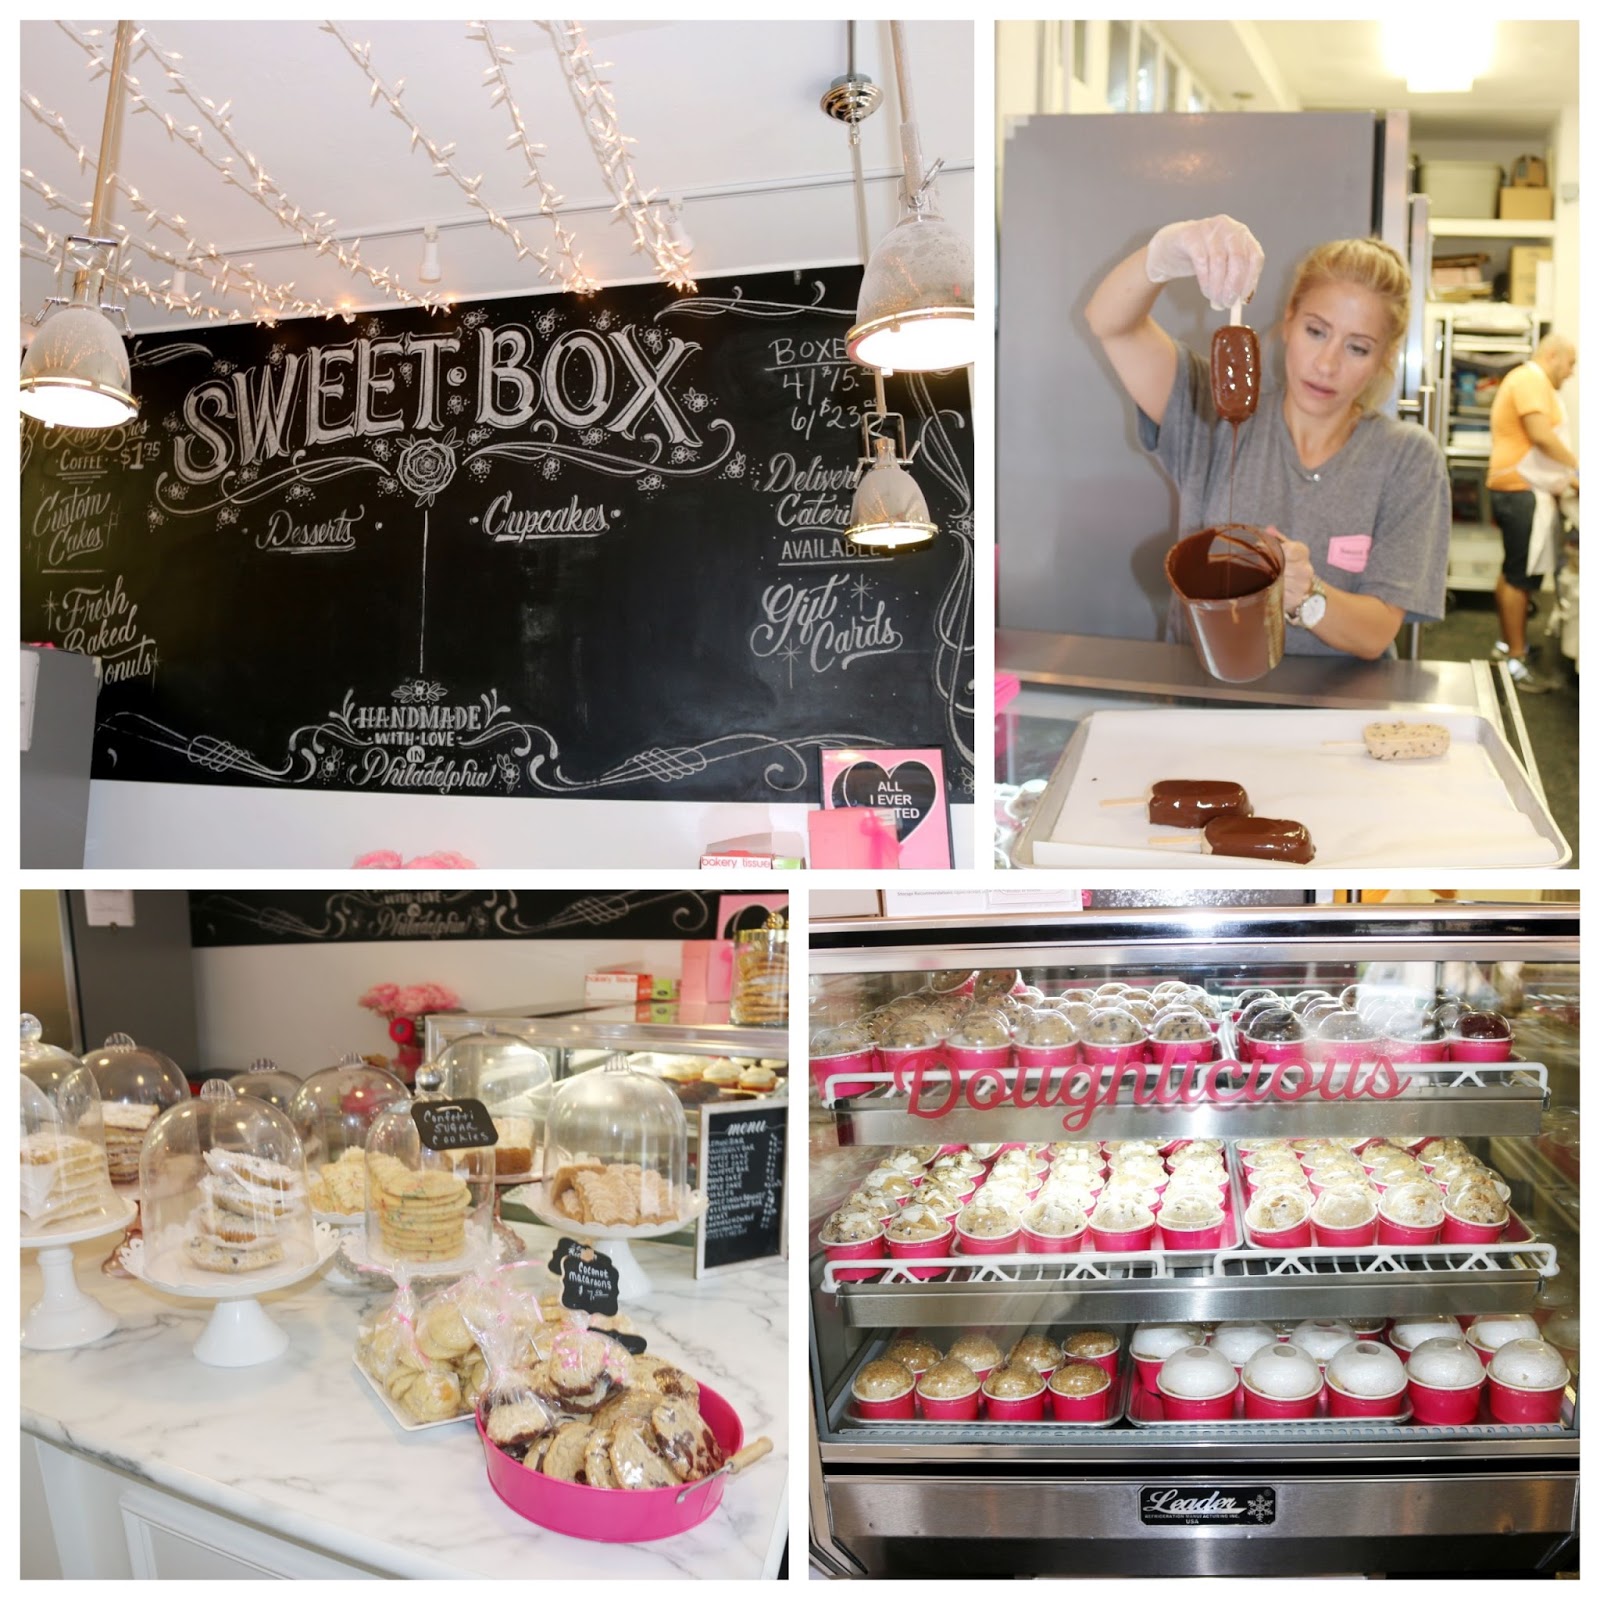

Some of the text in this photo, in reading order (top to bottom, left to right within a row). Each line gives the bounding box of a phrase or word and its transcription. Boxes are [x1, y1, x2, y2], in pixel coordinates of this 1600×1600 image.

[768, 338, 846, 365] BOXE
[175, 322, 702, 484] SWEET BOX
[33, 486, 110, 537] Custom
[256, 505, 364, 549] Desserts
[482, 488, 611, 542] Cupcakes
[776, 494, 850, 526] Cateri
[48, 521, 103, 566] Cakes
[56, 575, 129, 633] Fresh
[750, 574, 850, 657] Gift
[64, 604, 137, 655] Baked
[810, 601, 903, 673] Cards
[100, 635, 155, 688] onuts
[353, 705, 482, 731] HANDMADE
[374, 731, 455, 746] WITH LOVE
[347, 747, 497, 794] Philadelphia
[877, 781, 903, 792] ALL
[877, 794, 912, 806] EVER
[895, 808, 920, 819] TED
[701, 857, 771, 869] bakery tissue
[893, 1043, 1413, 1132] Doughlicious
[727, 1119, 767, 1136] menu
[578, 1261, 609, 1279] Coconut
[1143, 1489, 1247, 1514] Leader
